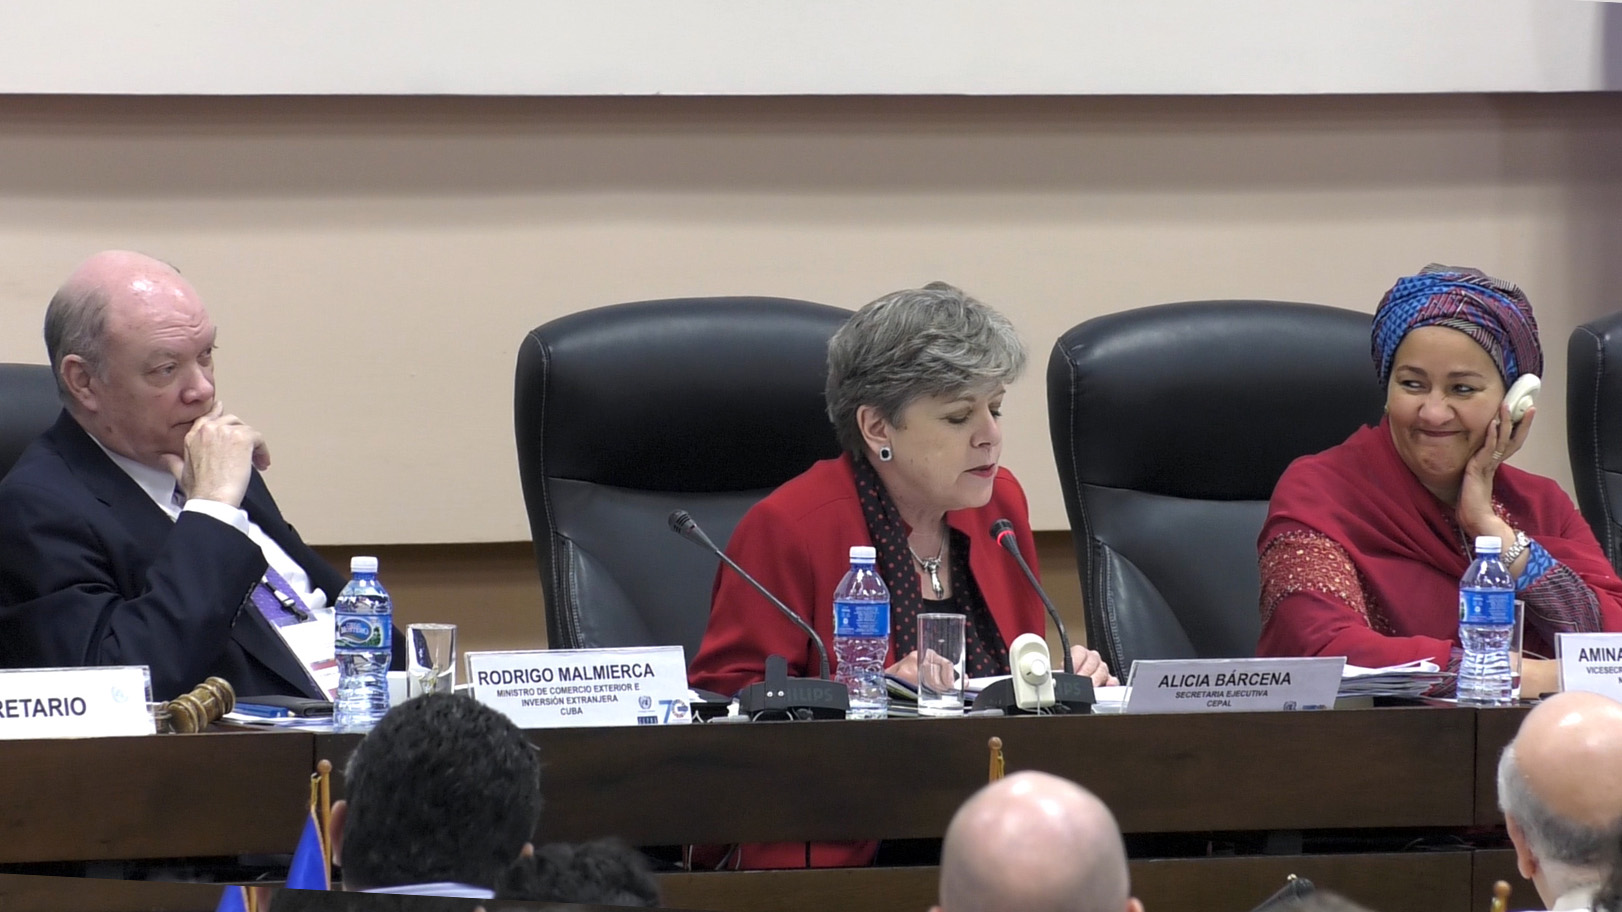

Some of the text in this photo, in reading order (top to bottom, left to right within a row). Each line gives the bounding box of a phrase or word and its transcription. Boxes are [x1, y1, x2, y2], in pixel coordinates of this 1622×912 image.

[477, 663, 656, 686] RODRIGO MALMIERCA
[1158, 669, 1291, 688] ALICIA BÁRCENA
[496, 682, 640, 697] MINISTRO DE COMERCIO EXTERIOR E
[785, 687, 833, 702] ILIPS
[1175, 690, 1268, 699] SECRETARIA EJECUTIVA
[521, 694, 618, 707] INVERSIÓN EXTRANJERA
[1206, 699, 1232, 708] CEPAL
[560, 706, 583, 716] CUBA
